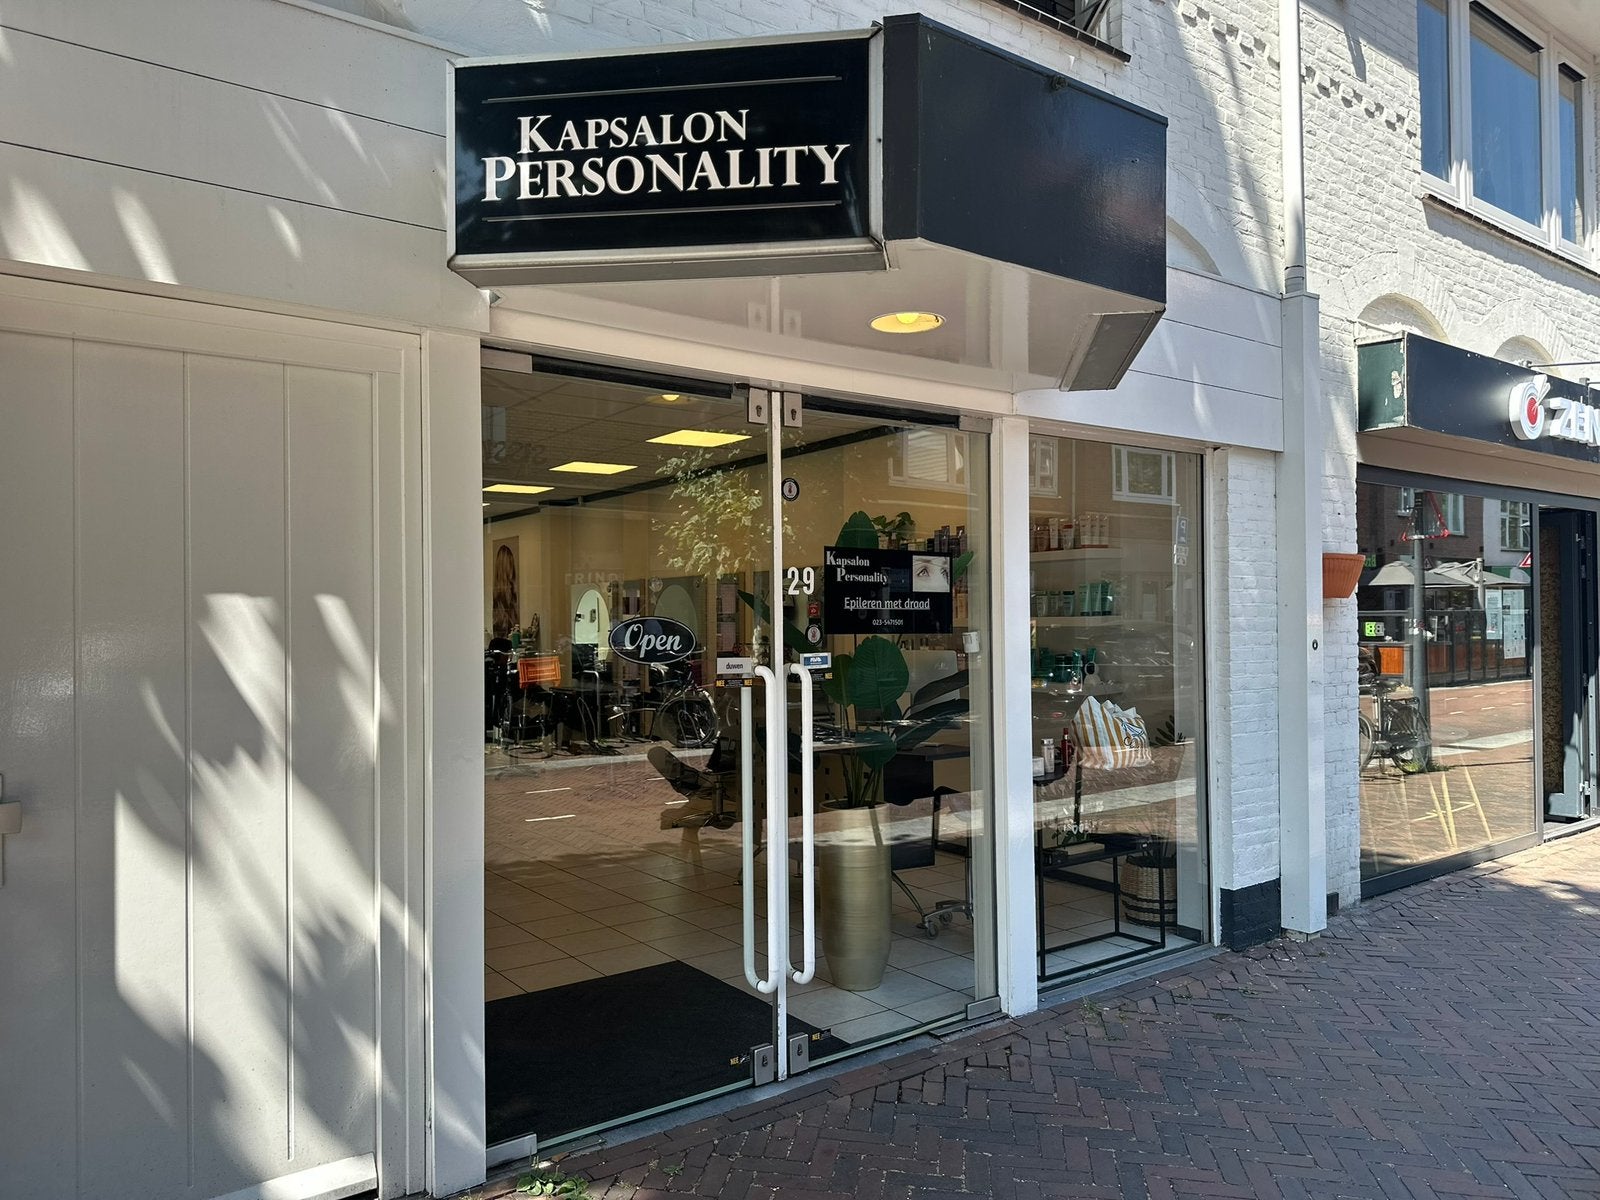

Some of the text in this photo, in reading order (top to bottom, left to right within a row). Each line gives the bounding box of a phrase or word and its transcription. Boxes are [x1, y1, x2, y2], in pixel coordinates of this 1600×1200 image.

[516, 109, 750, 154] KAPSALON
[481, 144, 851, 202] PERSONALITY
[826, 551, 870, 568] Kapsalon
[787, 566, 815, 595] 29
[836, 568, 889, 585] Personality
[843, 597, 931, 611] Epileren met draad
[624, 623, 683, 659] Open
[725, 661, 744, 670] duwen
